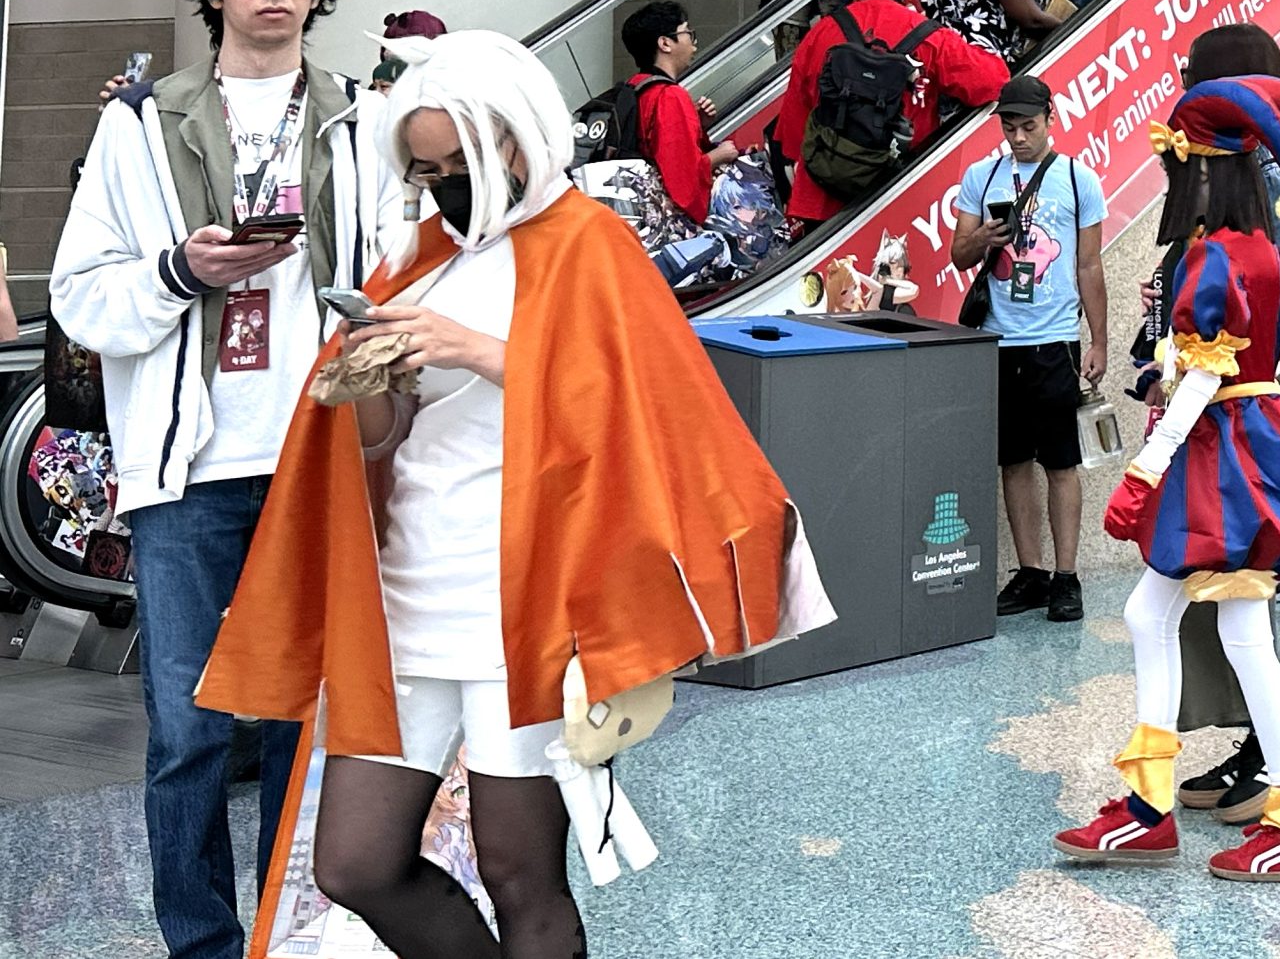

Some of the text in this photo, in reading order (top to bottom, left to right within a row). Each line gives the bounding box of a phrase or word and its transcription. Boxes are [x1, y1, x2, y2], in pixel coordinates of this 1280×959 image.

[1053, 26, 1151, 134] NEXT:
[1077, 71, 1176, 169] nly anime
[912, 566, 952, 582] Convention
[924, 548, 967, 566] Los Angeles
